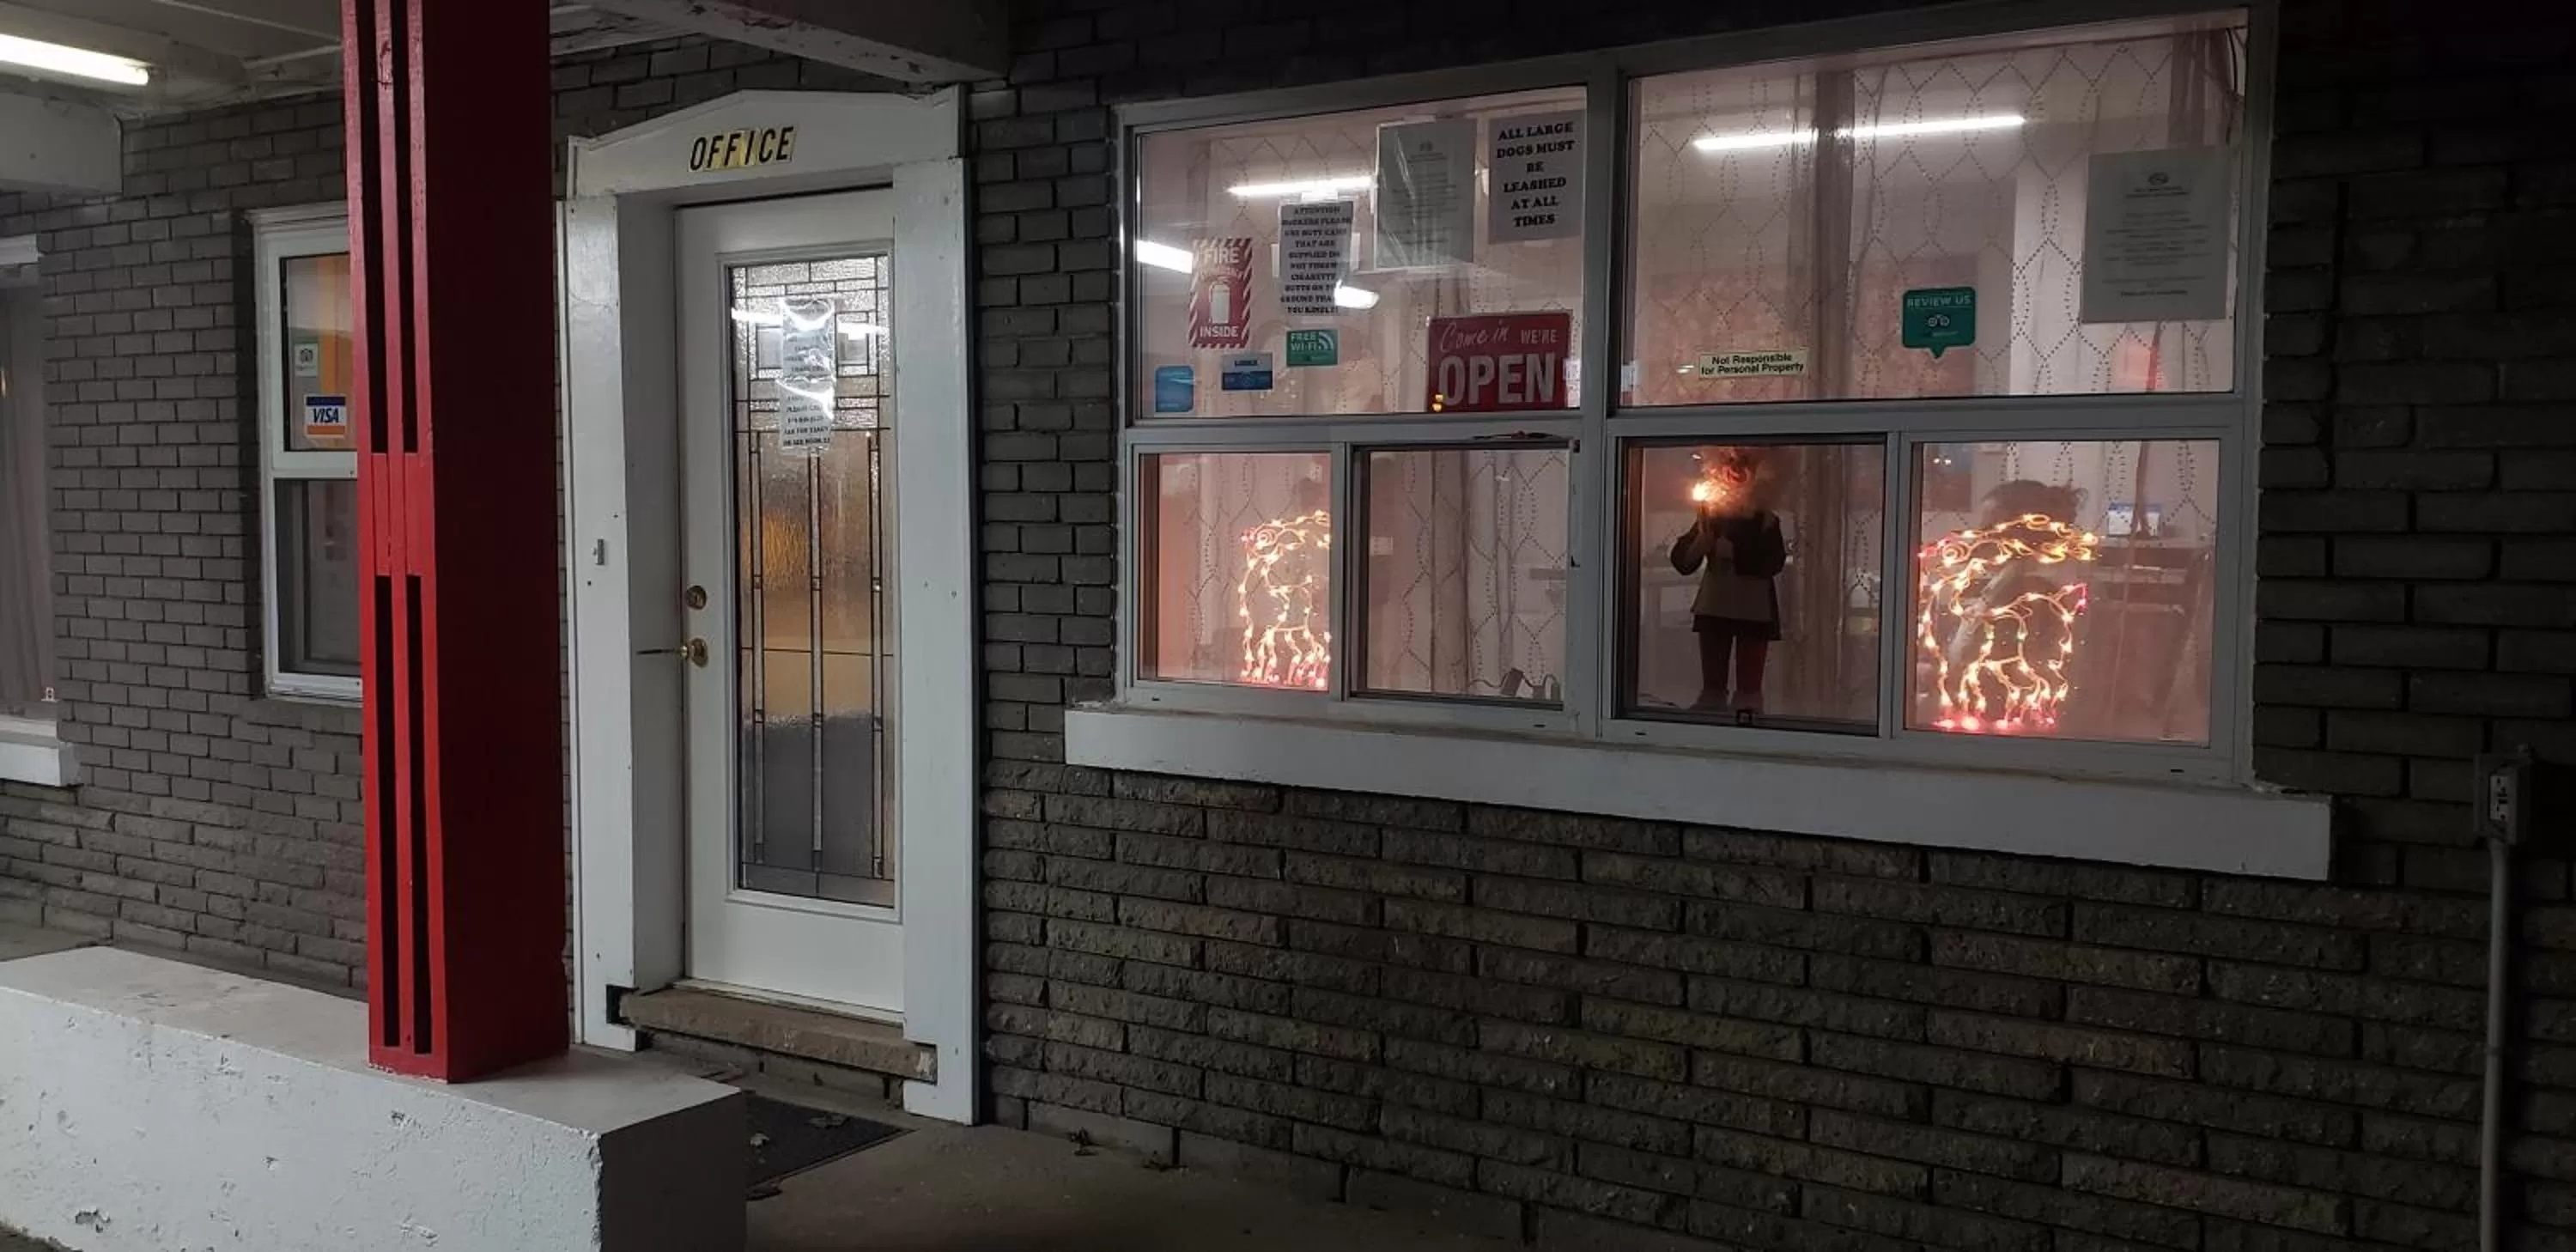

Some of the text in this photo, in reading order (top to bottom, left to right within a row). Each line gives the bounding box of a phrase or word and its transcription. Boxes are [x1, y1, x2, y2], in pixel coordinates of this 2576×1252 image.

[1498, 121, 1574, 141] ALL LARGE
[690, 126, 794, 170] OFFICE
[1497, 140, 1575, 158] DOGS MUST
[1526, 161, 1545, 172] BE
[1504, 177, 1567, 192] LEASHED
[1511, 195, 1560, 210] AT ALL
[1514, 214, 1555, 227] TIMES
[1202, 246, 1240, 264] FIRE
[1906, 295, 1971, 307] REVIEW US
[1200, 325, 1239, 337] INSIDE
[1291, 331, 1316, 342] FREE
[1440, 318, 1558, 353] Come in WE'RE
[1711, 353, 1792, 365] Not Responsible
[1701, 362, 1804, 375] for Personal Property
[1438, 352, 1556, 406] OPEN
[313, 408, 339, 423] VISA
